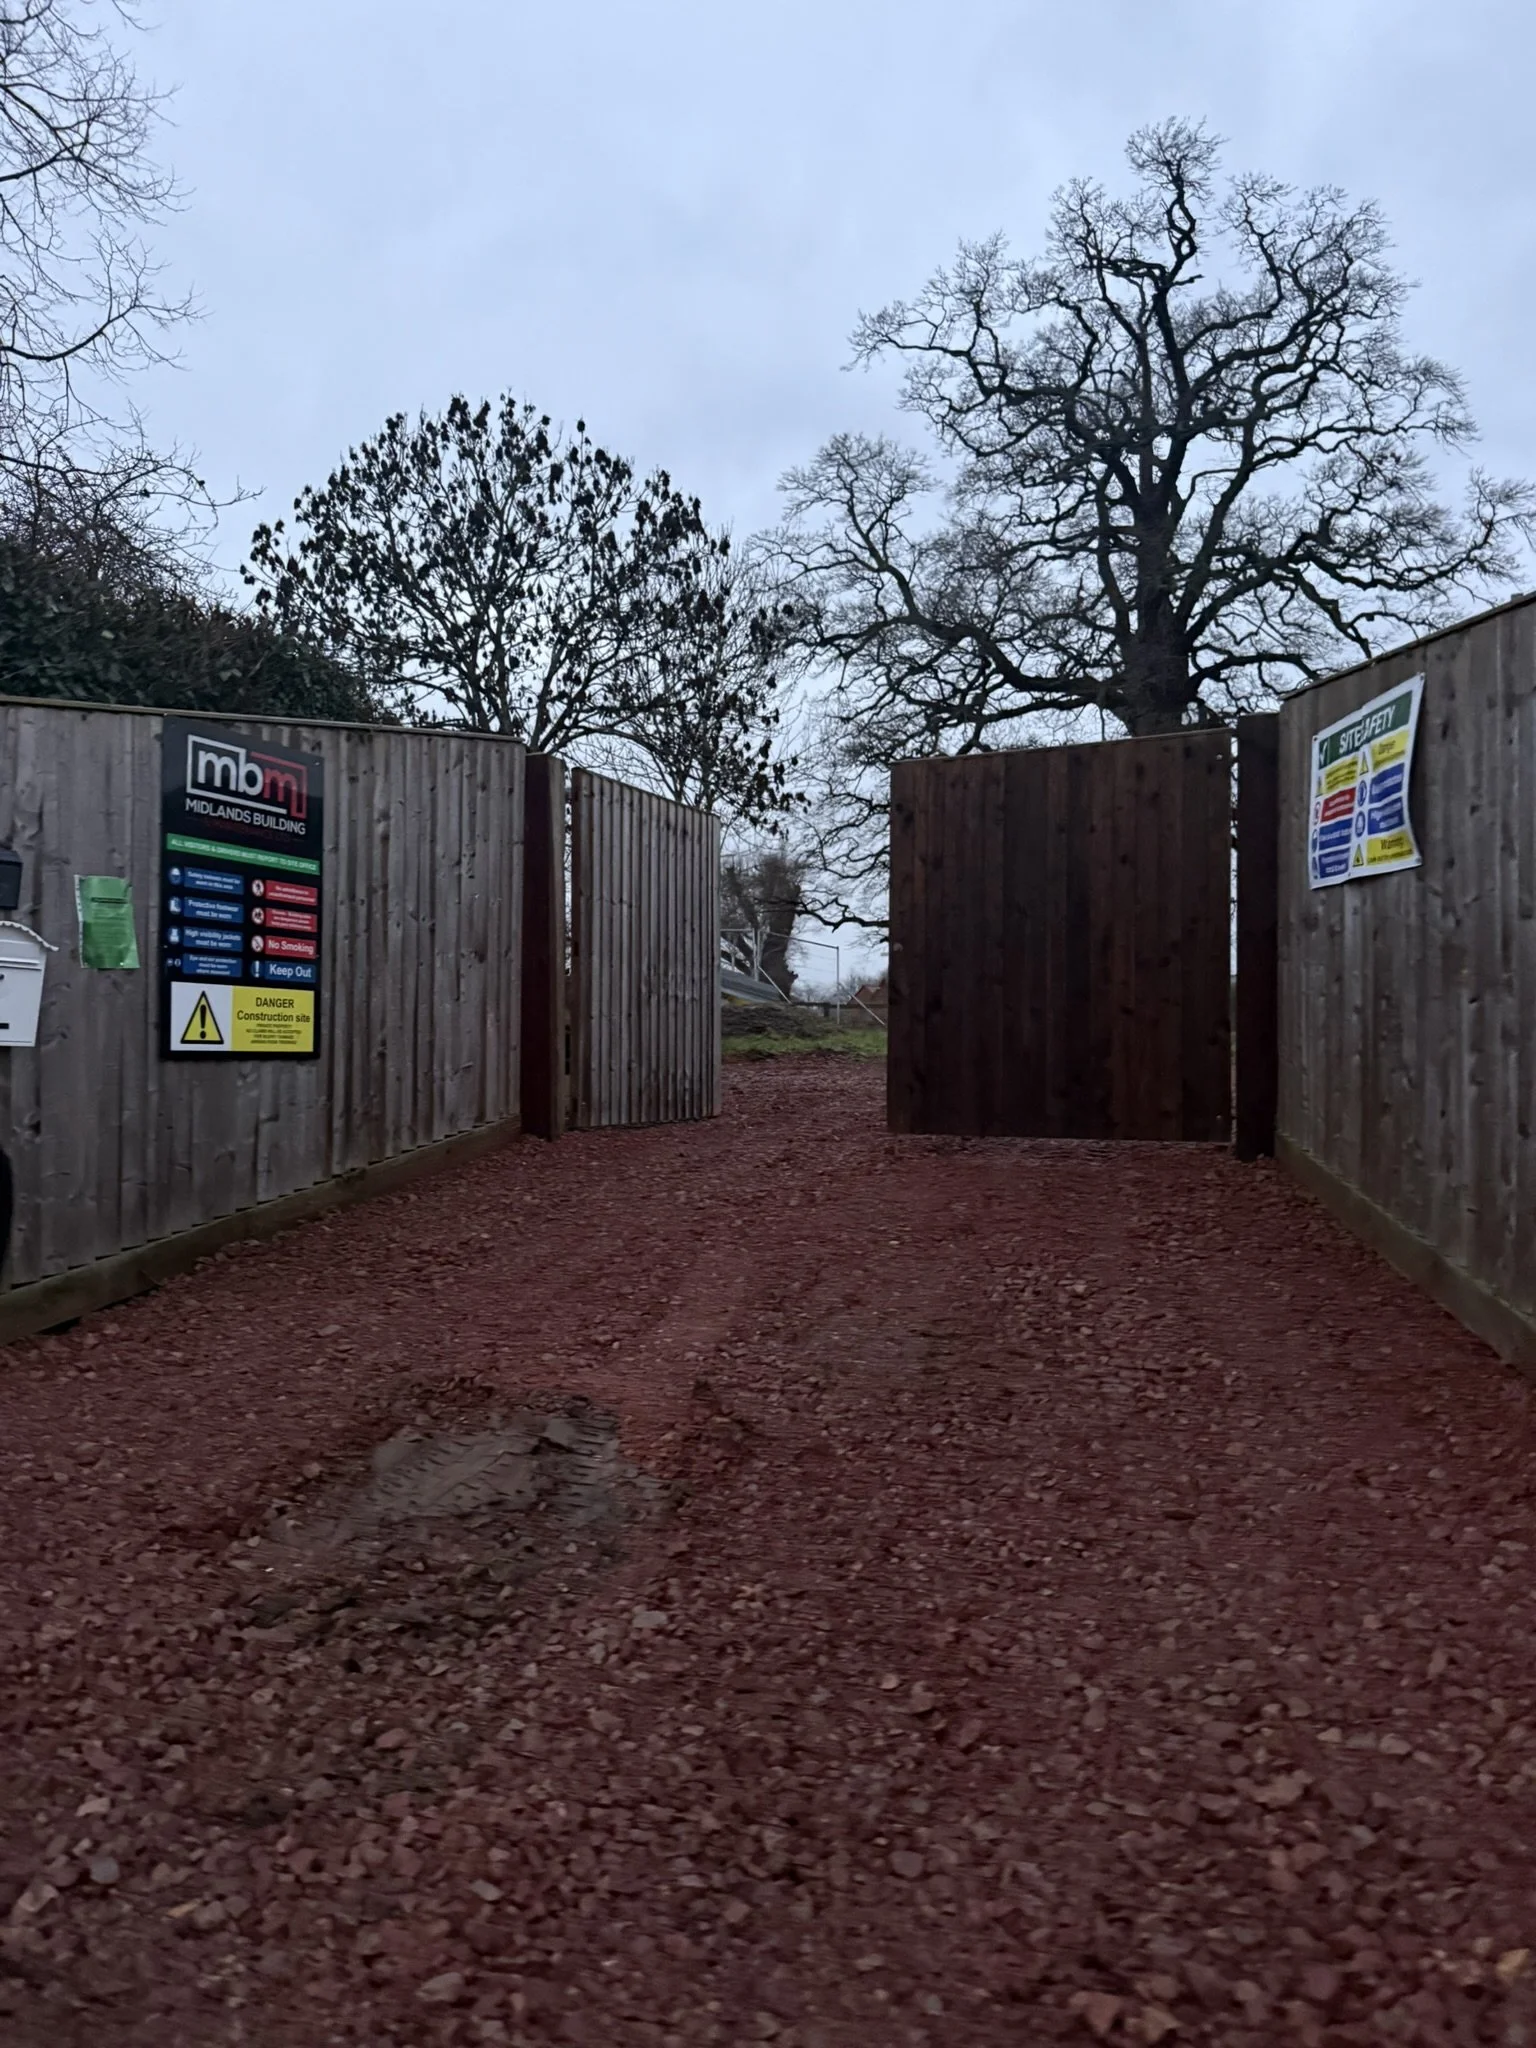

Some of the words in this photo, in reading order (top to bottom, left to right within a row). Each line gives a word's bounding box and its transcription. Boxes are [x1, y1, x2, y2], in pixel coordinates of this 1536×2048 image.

[1339, 726, 1362, 755] SITE
[197, 749, 307, 819] mbm
[185, 798, 252, 824] MIDLANDS
[253, 815, 306, 835] BUILDING
[268, 939, 280, 949] No
[280, 940, 314, 955] Smoking
[269, 963, 293, 979] Keep
[295, 966, 312, 978] Out
[255, 997, 295, 1008] DANGER
[236, 1010, 294, 1022] Construction
[295, 1013, 311, 1023] site
